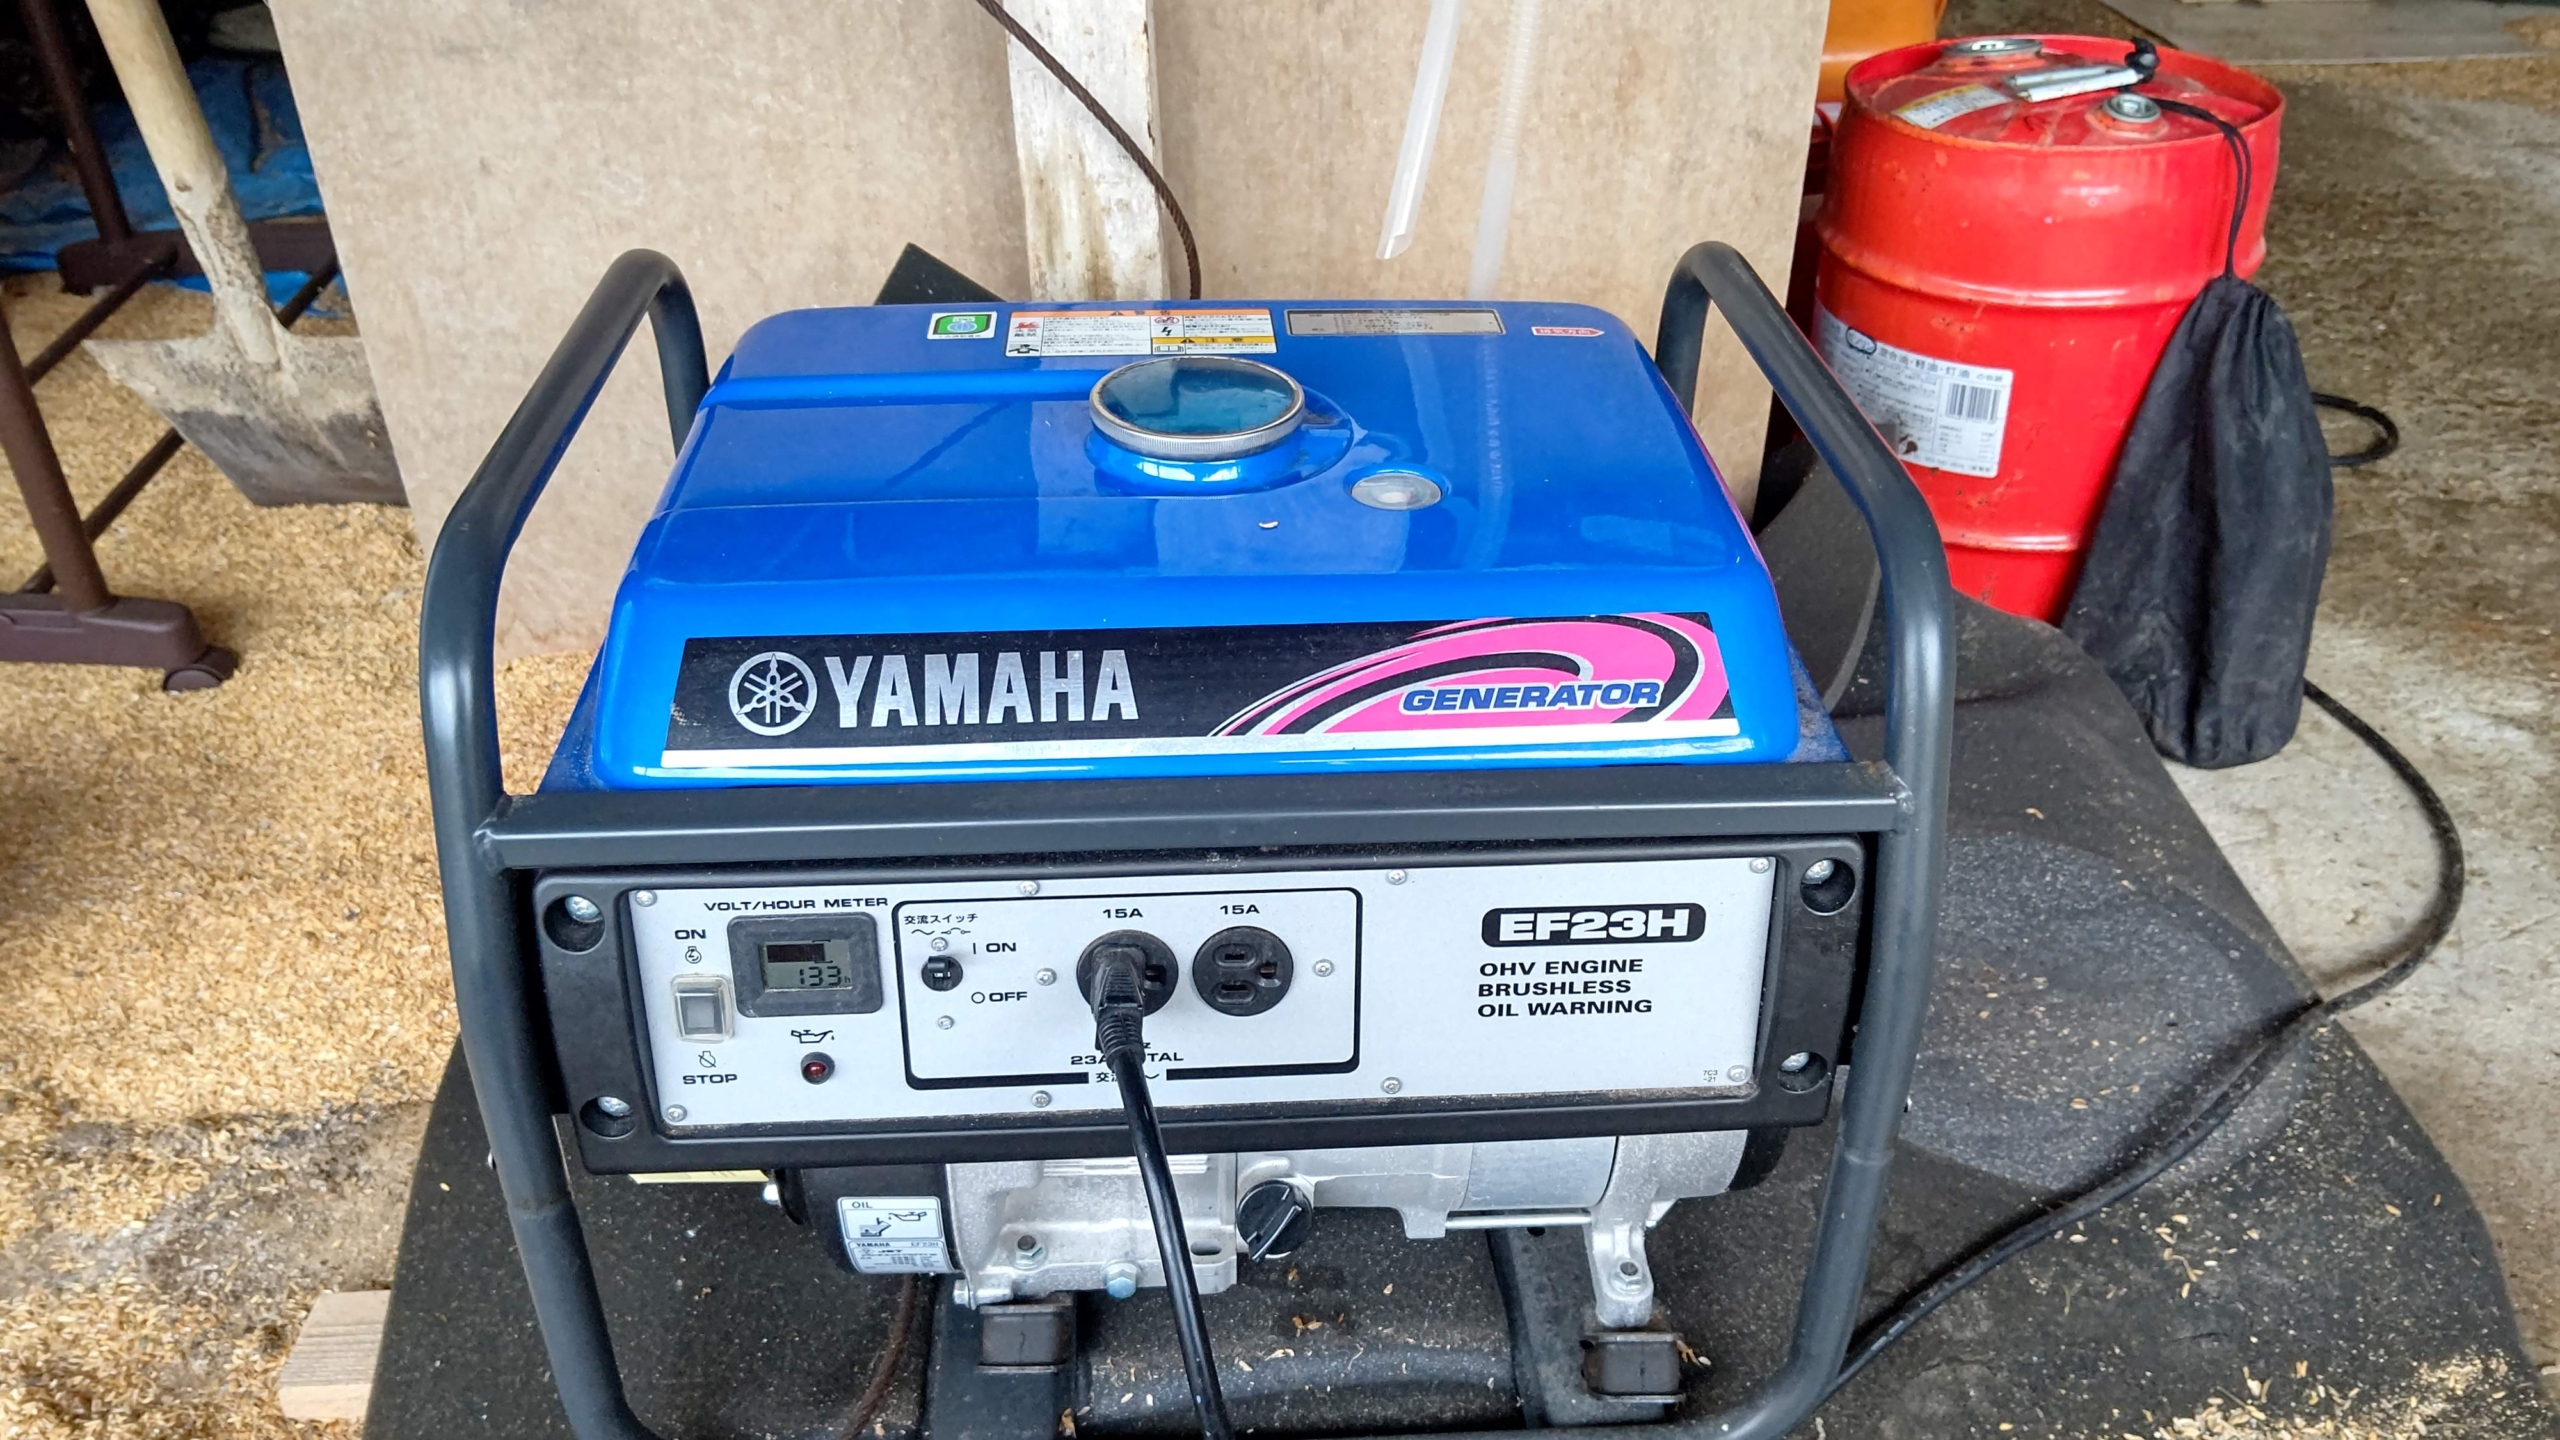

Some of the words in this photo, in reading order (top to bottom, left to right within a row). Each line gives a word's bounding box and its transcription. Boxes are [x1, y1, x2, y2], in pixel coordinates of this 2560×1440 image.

[824, 648, 1140, 729] YAMAHA
[1401, 681, 1662, 713] GENERATOR
[703, 899, 816, 912] VOLT/HOUR
[823, 897, 889, 909] METER
[1219, 904, 1260, 915] 15A
[903, 913, 979, 925] 交流スイッチ
[1102, 907, 1144, 919] 15A
[1499, 908, 1690, 942] EF23H
[674, 928, 707, 940] ON
[985, 942, 1017, 953] ON
[1479, 961, 1536, 977] OHV
[1544, 958, 1644, 975] ENGINE
[1478, 979, 1632, 998] BRUSHLESS
[988, 991, 1028, 1003] OFF
[1477, 1003, 1519, 1018] OIL
[1527, 999, 1652, 1017] WARNING
[682, 1073, 738, 1085] STOP
[851, 1201, 873, 1209] OIL
